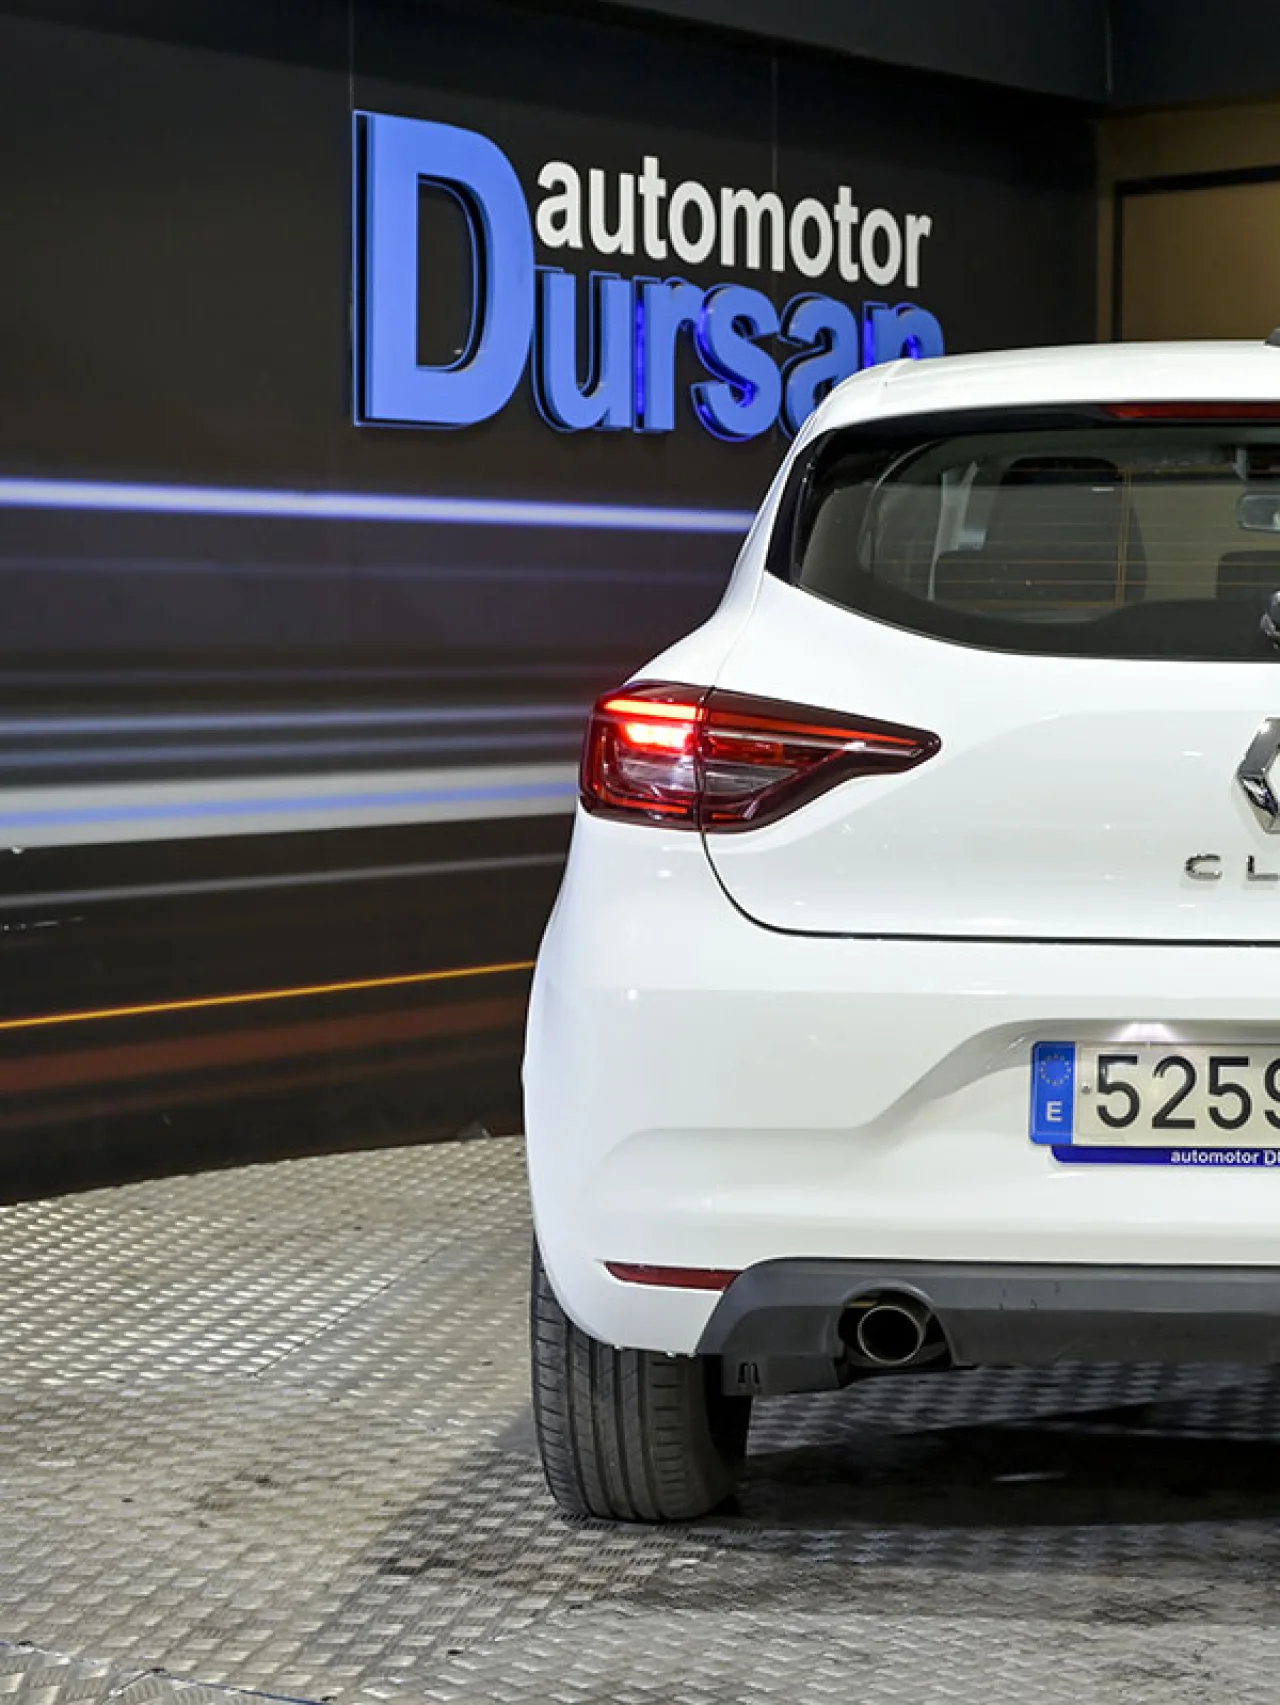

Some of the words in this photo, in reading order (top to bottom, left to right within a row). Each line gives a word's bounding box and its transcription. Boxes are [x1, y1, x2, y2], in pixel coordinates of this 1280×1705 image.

[535, 156, 932, 288] automotor
[1046, 1101, 1063, 1121] E
[1170, 1150, 1261, 1164] automotor
